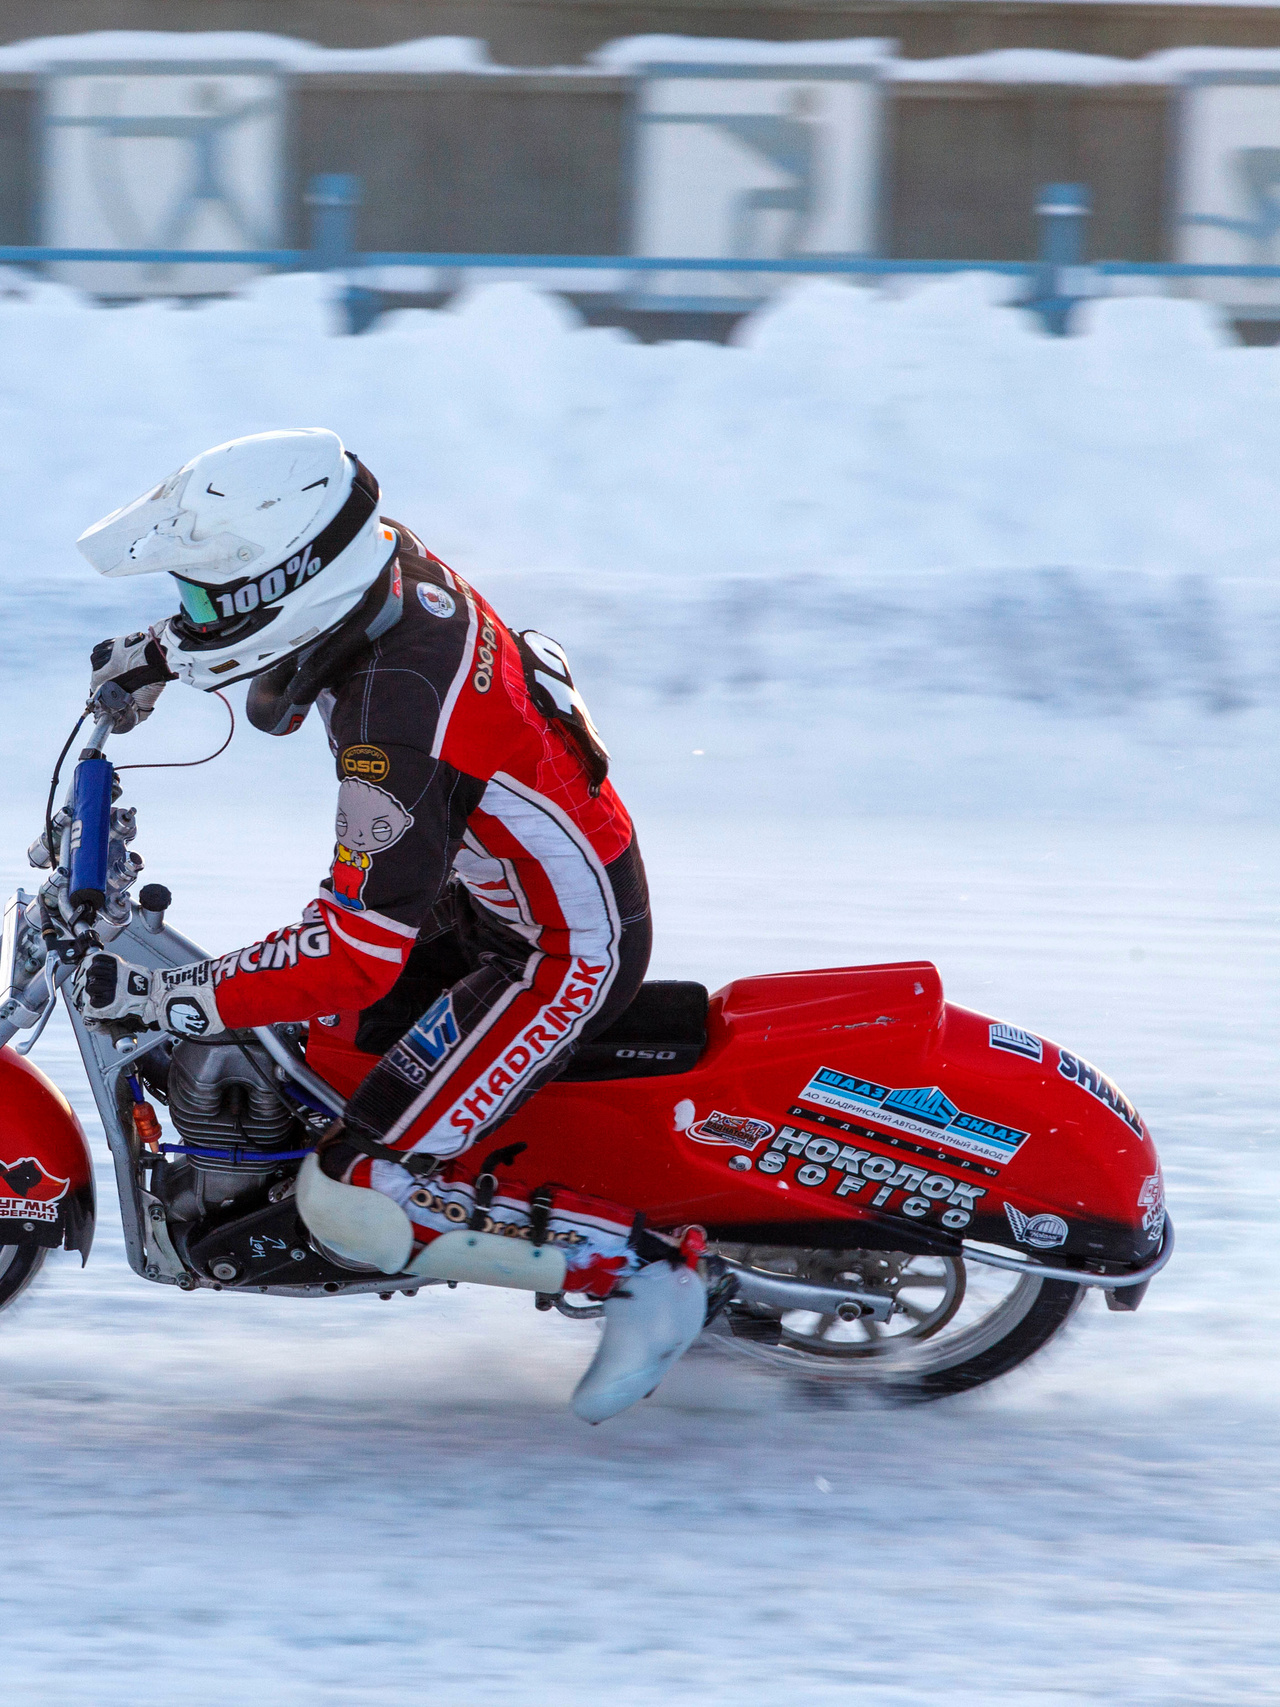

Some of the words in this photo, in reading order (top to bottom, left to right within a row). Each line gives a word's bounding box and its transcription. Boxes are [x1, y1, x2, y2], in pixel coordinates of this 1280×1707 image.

[215, 543, 322, 618] 100%
[449, 956, 607, 1135] SHADRINSK
[803, 1091, 820, 1100] АО
[891, 1118, 971, 1149] АВТОАГРЕГАТНЫЙ
[817, 1070, 887, 1099] ШААЗ
[955, 1115, 1023, 1144] SHAAZ
[757, 1150, 971, 1229] SOFICO
[771, 1126, 987, 1210] НОКОЛОК
